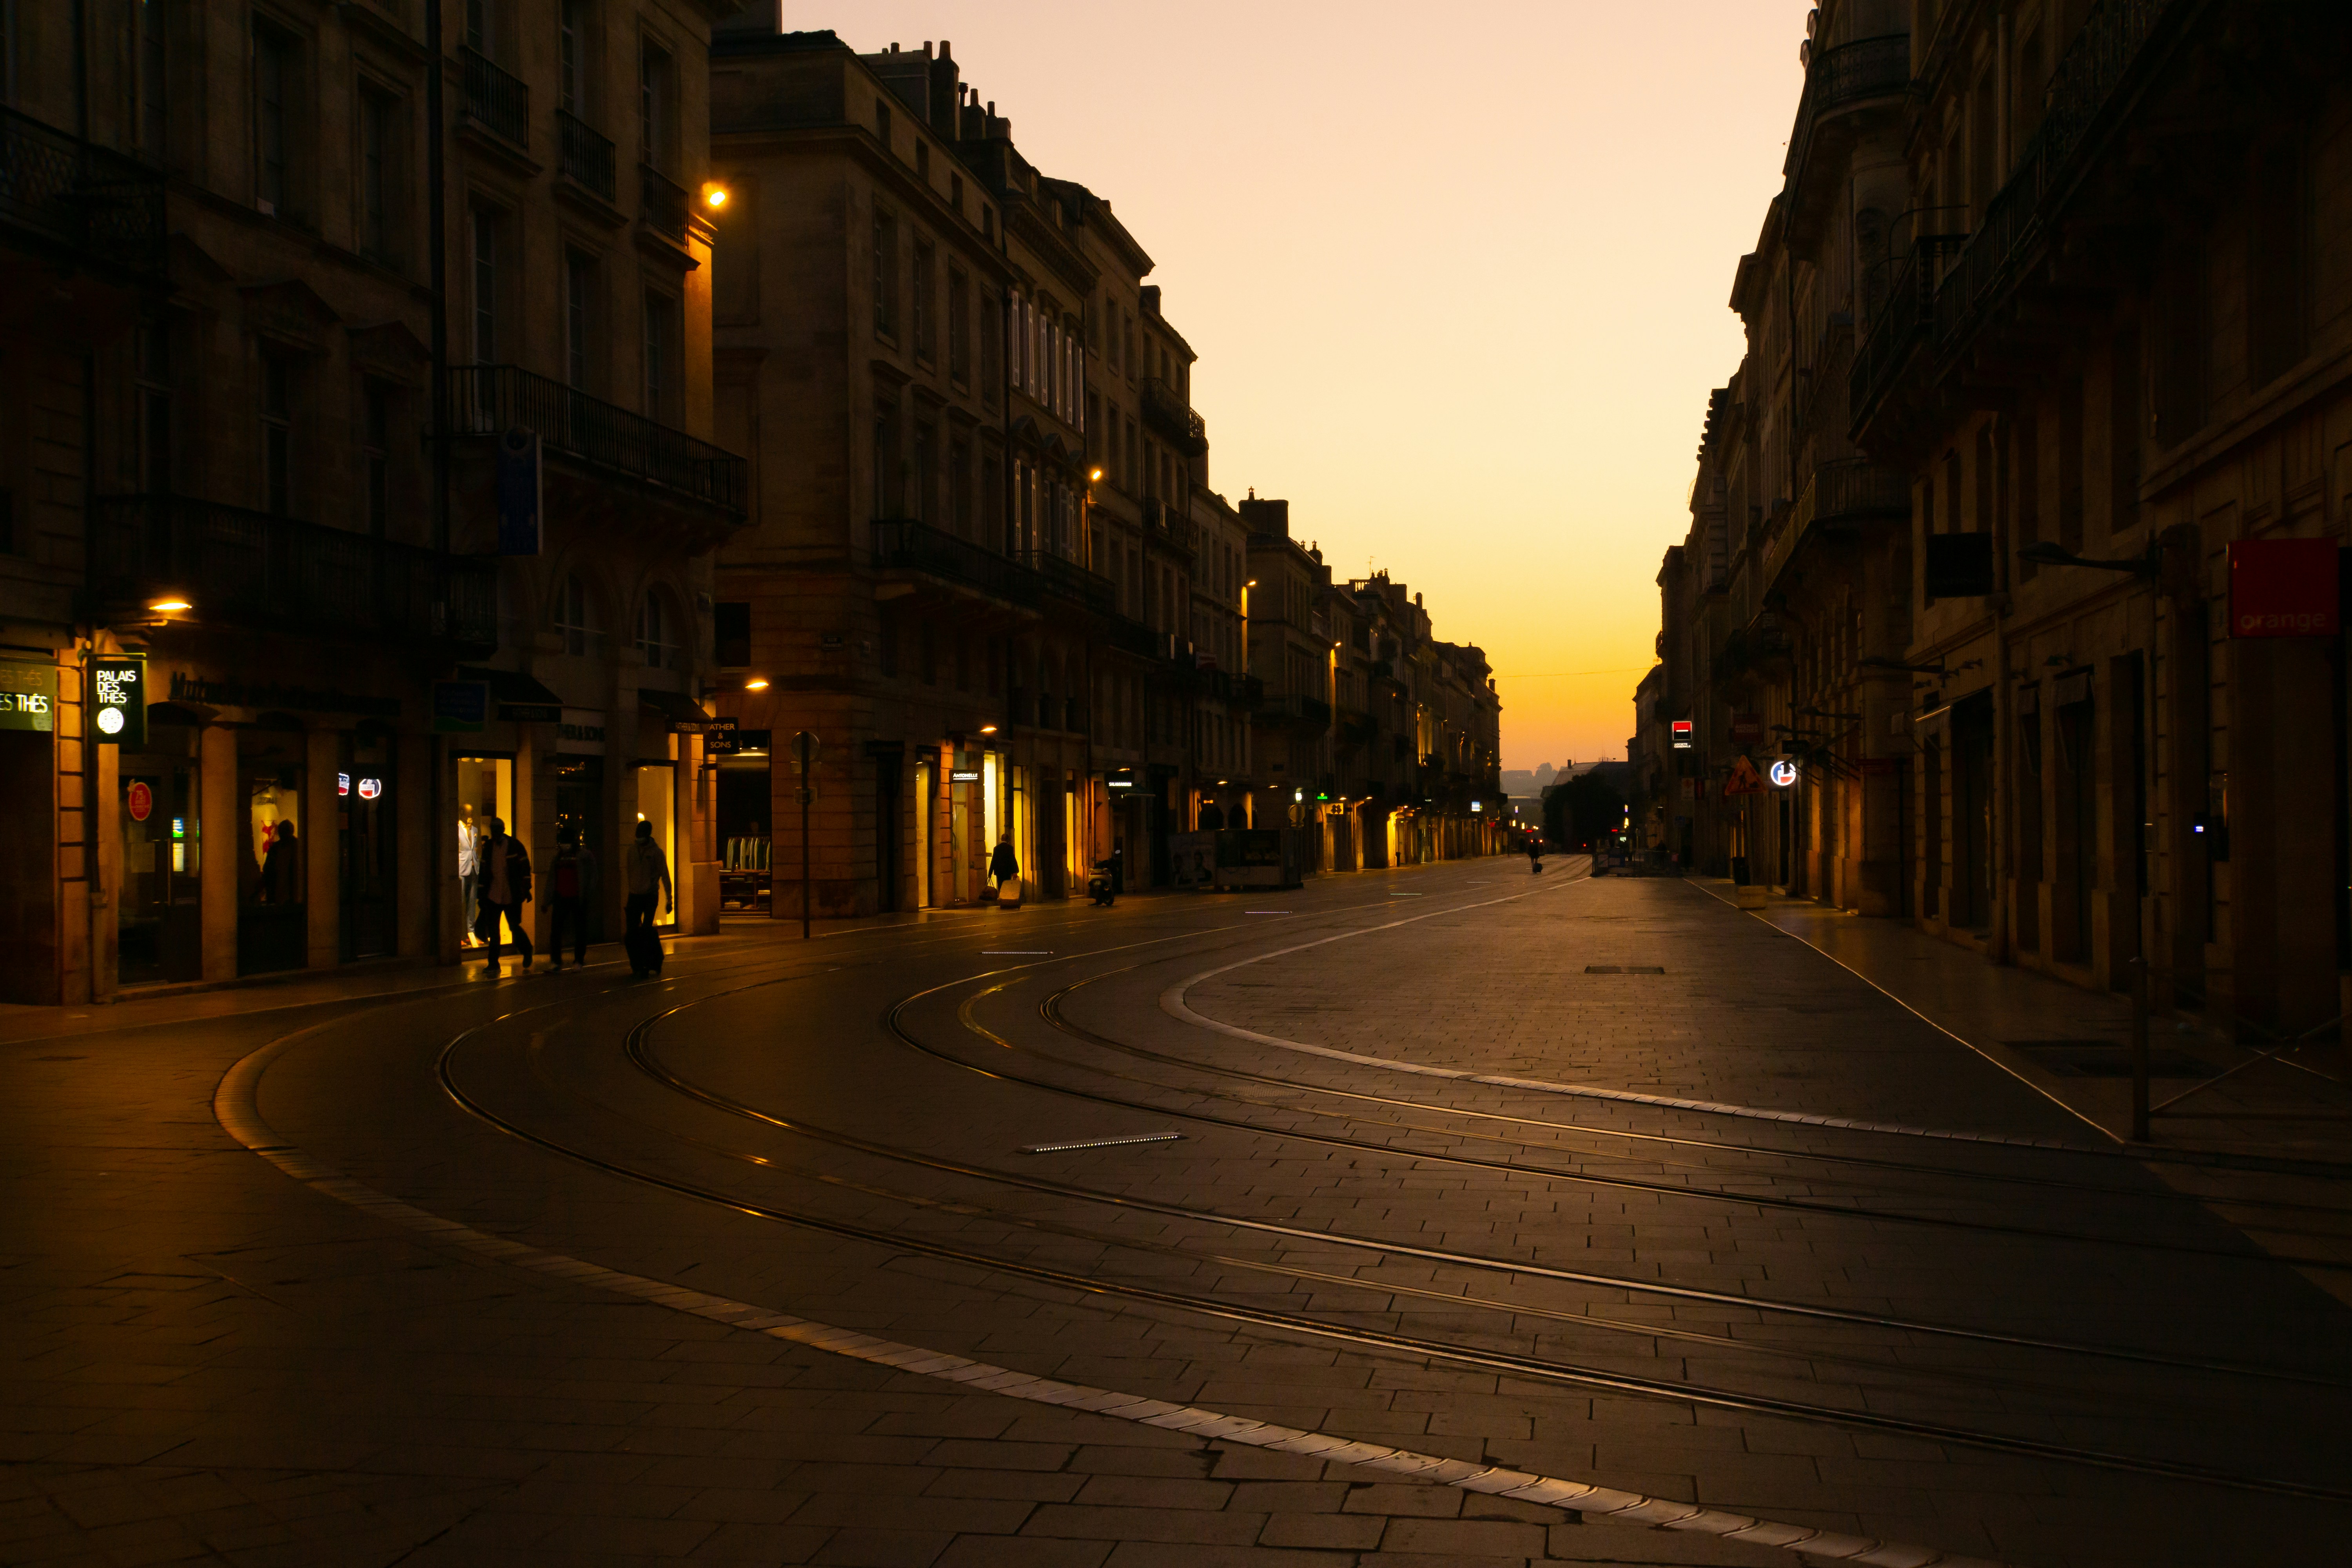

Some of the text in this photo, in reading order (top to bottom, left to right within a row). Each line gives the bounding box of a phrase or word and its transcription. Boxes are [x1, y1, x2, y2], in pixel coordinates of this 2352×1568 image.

[2240, 613, 2326, 632] orange
[96, 670, 136, 681] PALAIS
[97, 681, 120, 692] DES
[16, 693, 48, 713] THÉS
